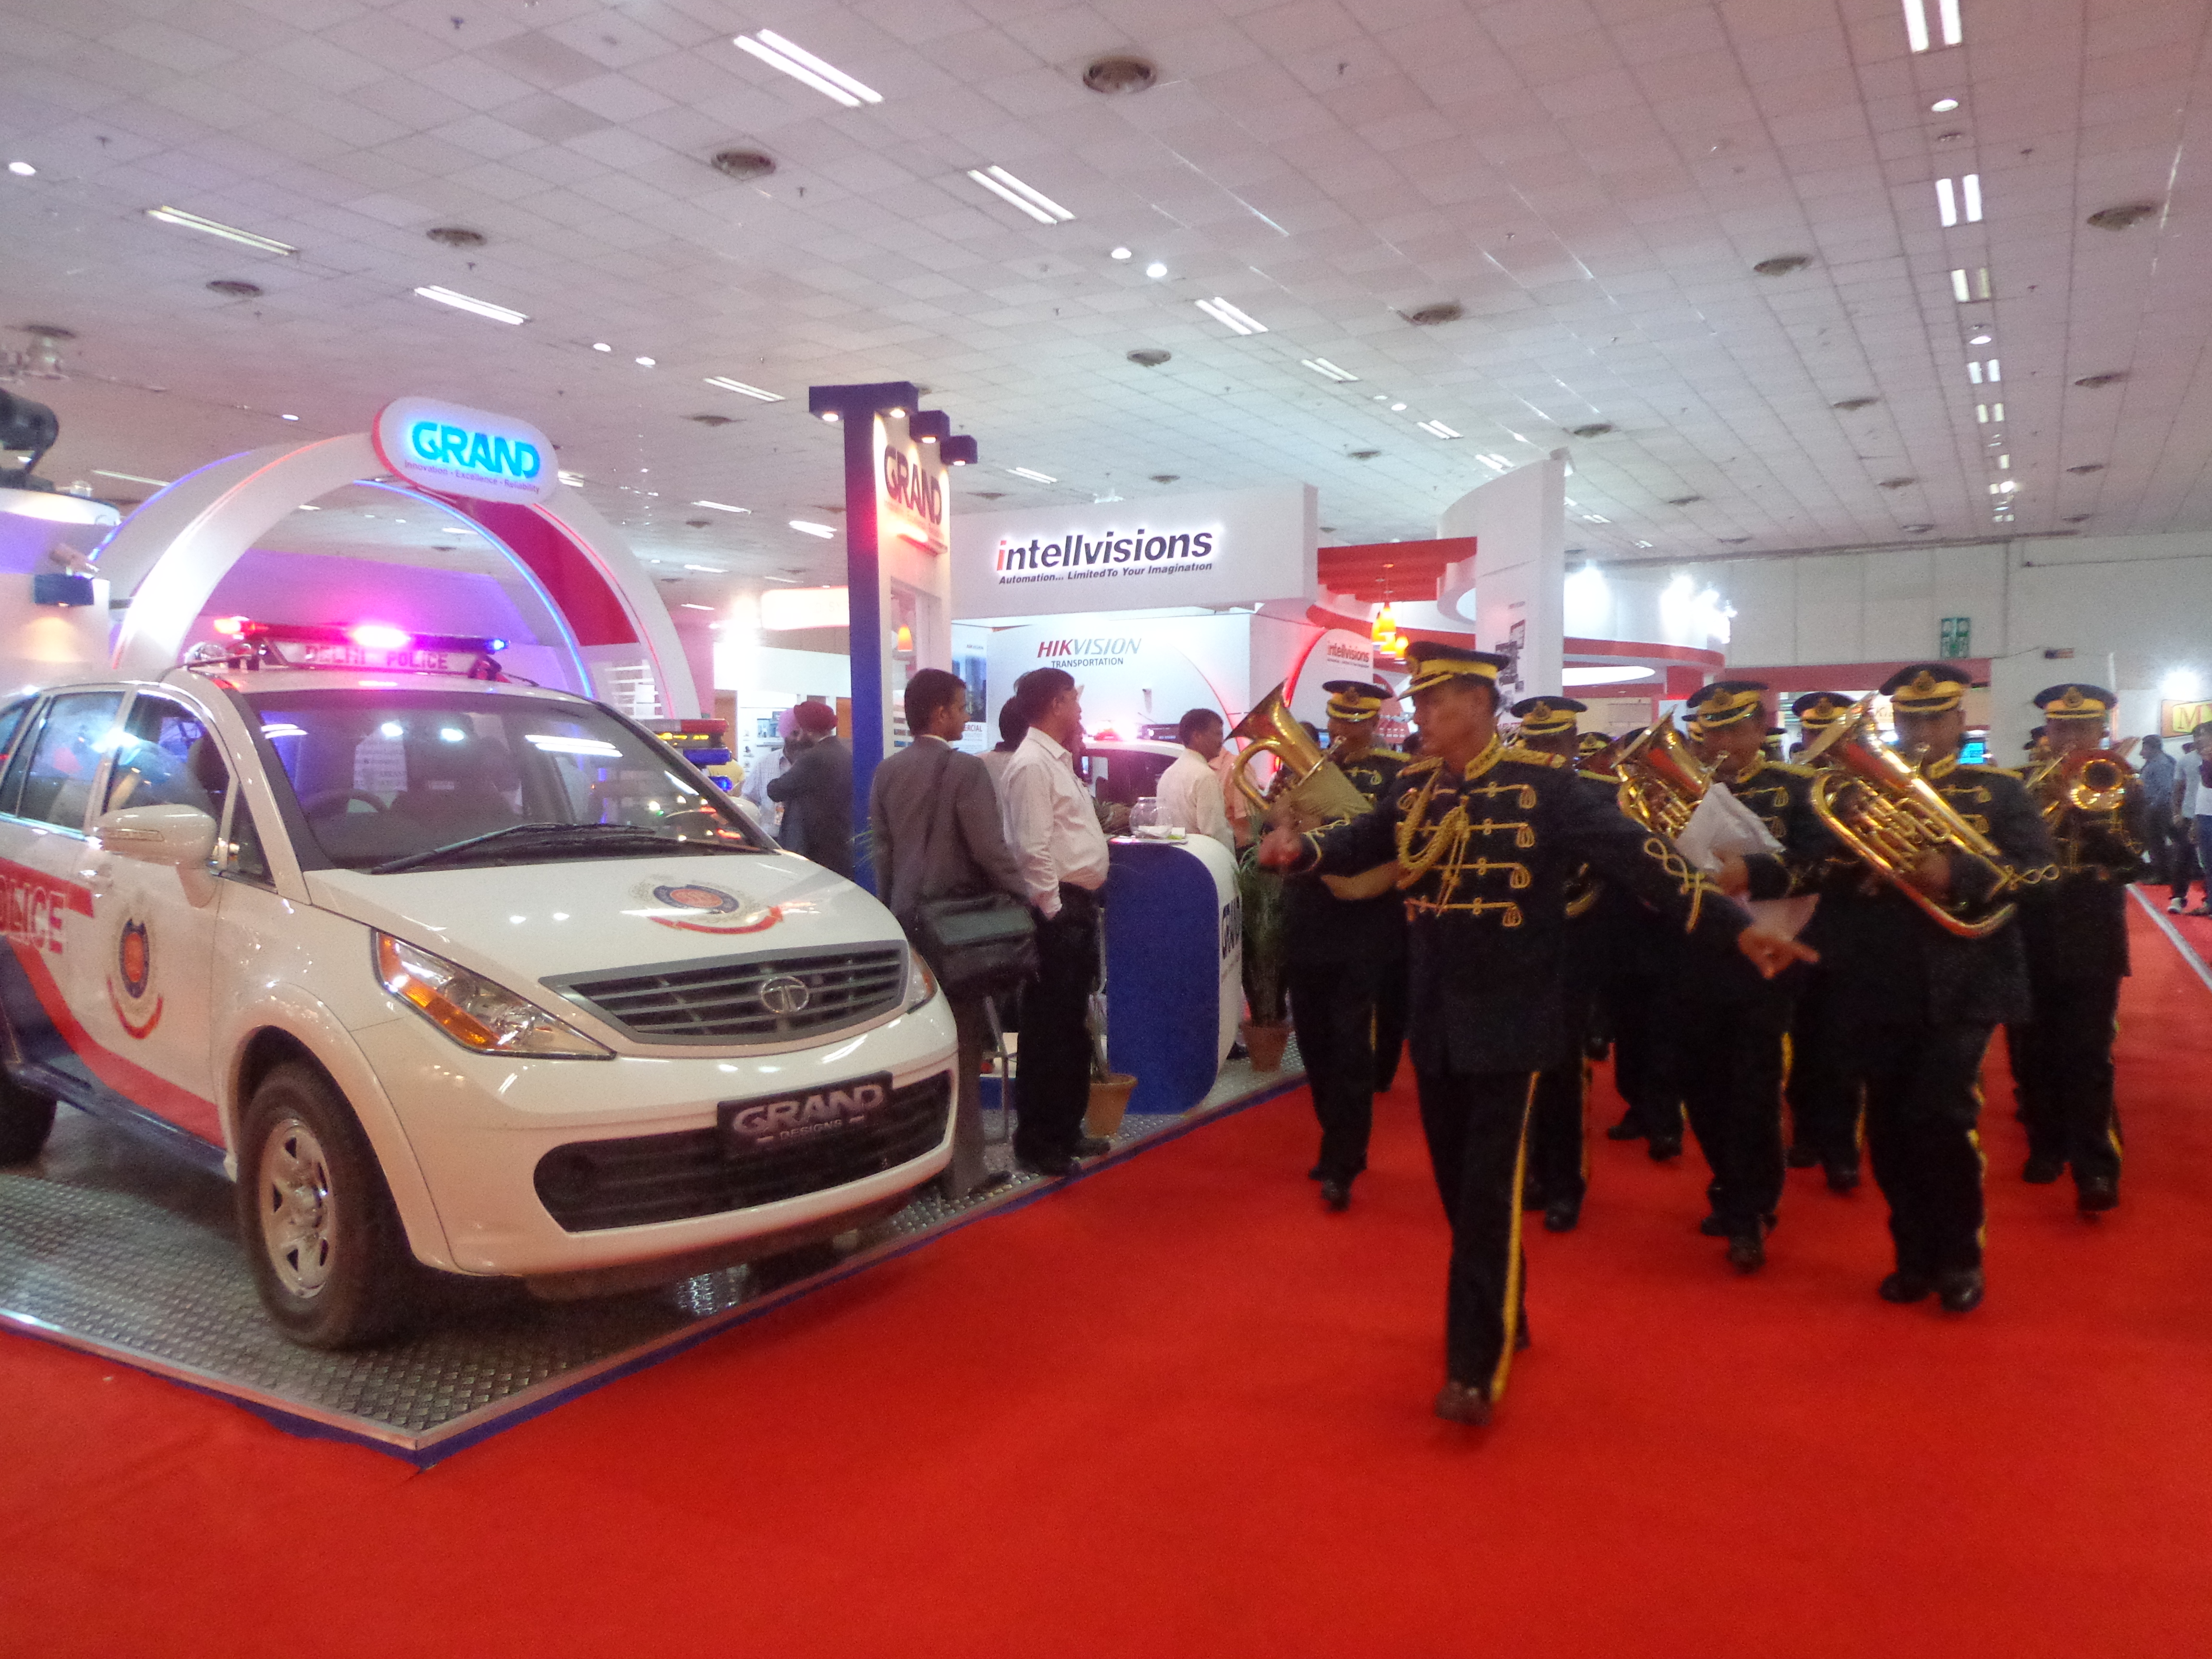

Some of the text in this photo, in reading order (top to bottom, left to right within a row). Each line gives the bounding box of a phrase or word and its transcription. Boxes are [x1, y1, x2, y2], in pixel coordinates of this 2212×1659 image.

[412, 421, 540, 479] GRAND
[405, 459, 540, 494] Innovation Excellence Reliability
[884, 445, 942, 525] GRAND
[997, 529, 1213, 571] intellvisions
[1123, 567, 1145, 577] Your
[1148, 563, 1213, 575] Imagination
[305, 645, 448, 670] DELHI POLICE
[1037, 638, 1142, 658] HIKVISION
[1051, 657, 1124, 668] TRANSPORTATION
[733, 1084, 884, 1133] GRAND
[780, 1118, 842, 1140] DESIGNS
